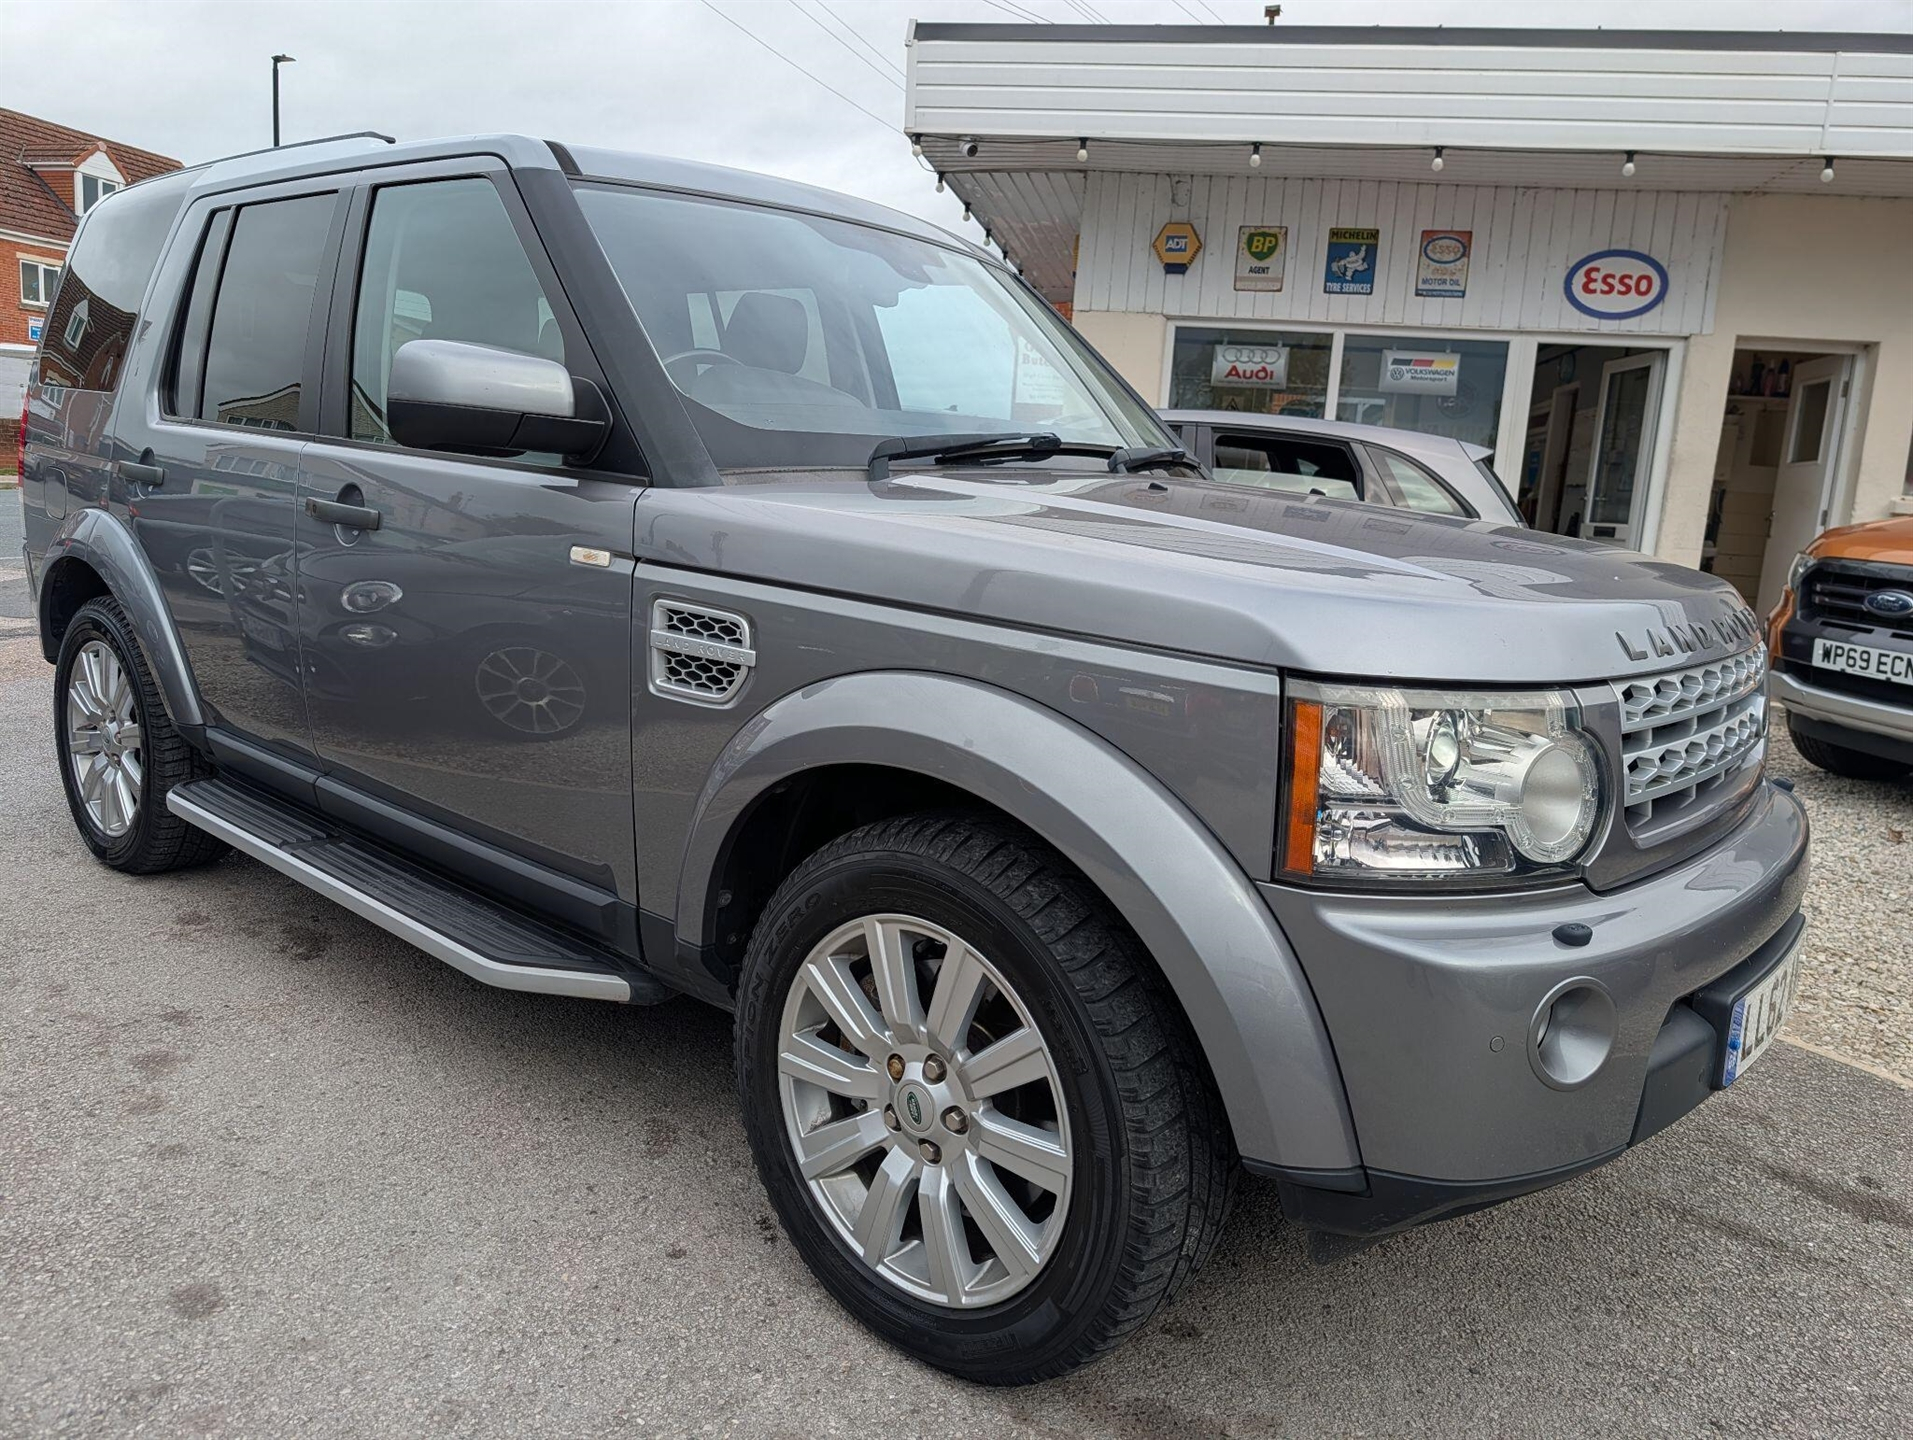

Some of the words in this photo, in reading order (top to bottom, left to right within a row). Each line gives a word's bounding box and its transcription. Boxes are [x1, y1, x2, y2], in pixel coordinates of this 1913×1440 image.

[1330, 230, 1378, 241] MICHELIN
[1165, 238, 1188, 250] ADT
[1250, 236, 1276, 253] BP
[1248, 266, 1271, 275] AGENT
[1421, 277, 1448, 287] MOTOR
[1448, 278, 1461, 287] OIL
[1581, 266, 1653, 297] Esso
[1325, 282, 1340, 293] TYRE
[1341, 283, 1371, 294] SERVICES
[1223, 364, 1275, 381] Audi
[1405, 367, 1456, 377] VOLKSWAGEN
[1615, 621, 1714, 662] LAND
[1821, 642, 1871, 671] WP69
